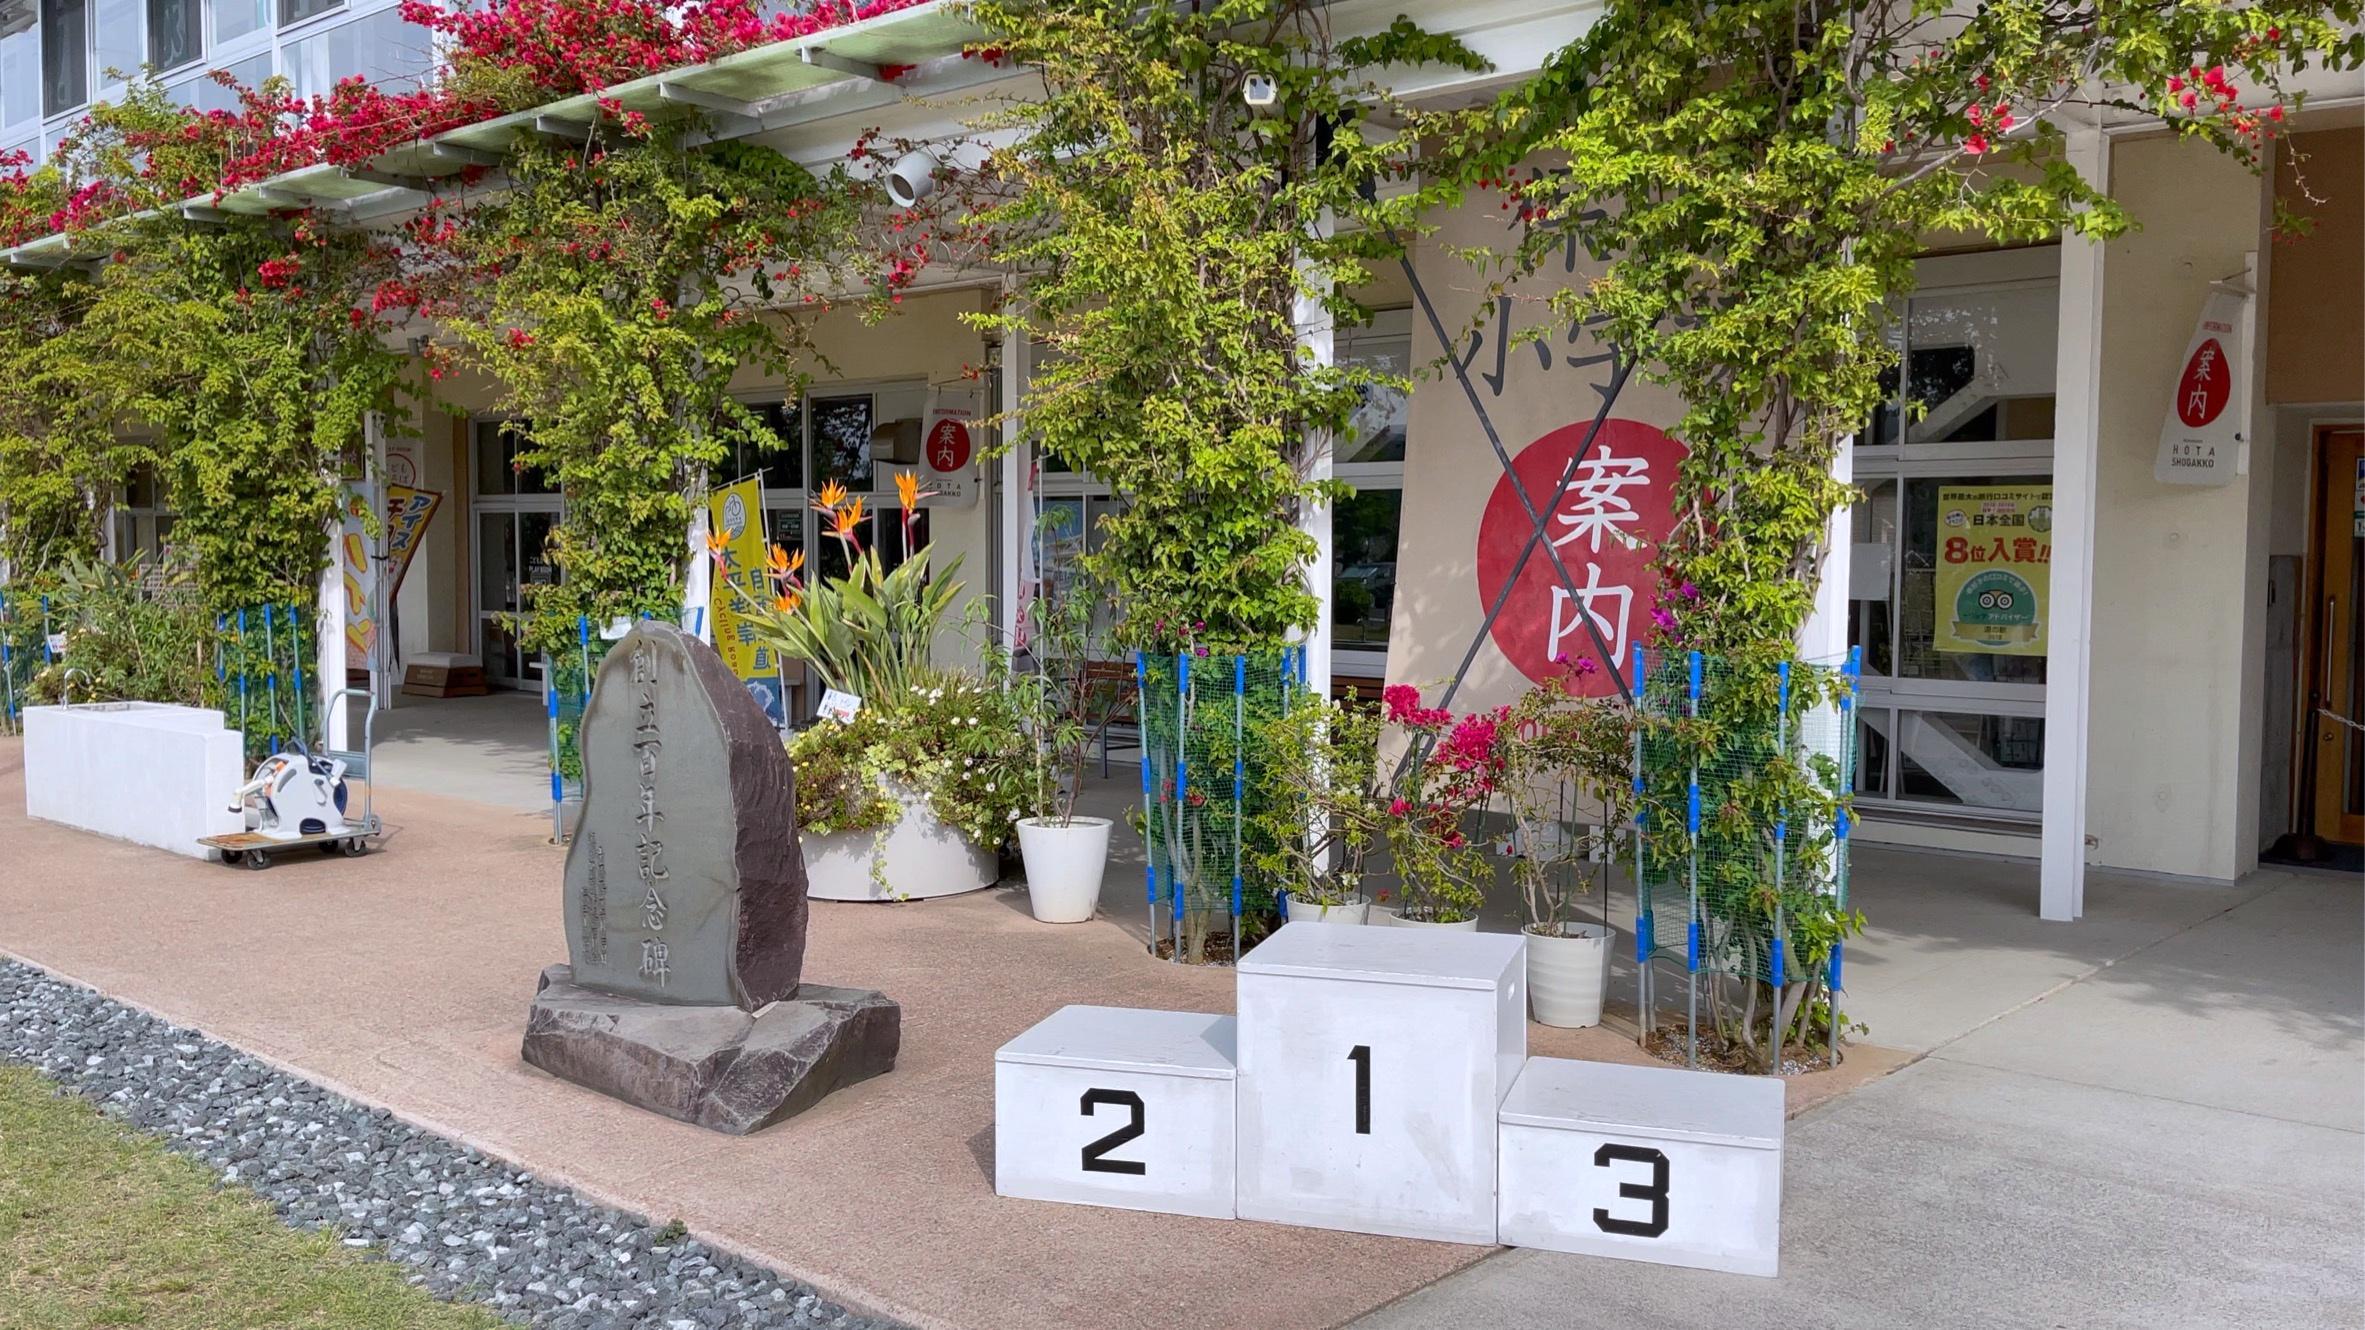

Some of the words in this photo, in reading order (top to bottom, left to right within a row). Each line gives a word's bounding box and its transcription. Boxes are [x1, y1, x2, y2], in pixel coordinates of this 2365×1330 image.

[2186, 347, 2216, 420] 案内
[936, 423, 957, 468] 案内
[2171, 457, 2215, 468] SHOGAKKO
[2172, 443, 2216, 457] HOTA
[391, 495, 432, 550] アイス
[1973, 514, 2025, 526] 日本全国
[1547, 444, 1651, 671] 案内
[630, 639, 671, 988] 創立百年記念碑
[1346, 1044, 1372, 1135] 1
[1080, 1087, 1146, 1176] 2
[1593, 1142, 1671, 1239] 3
